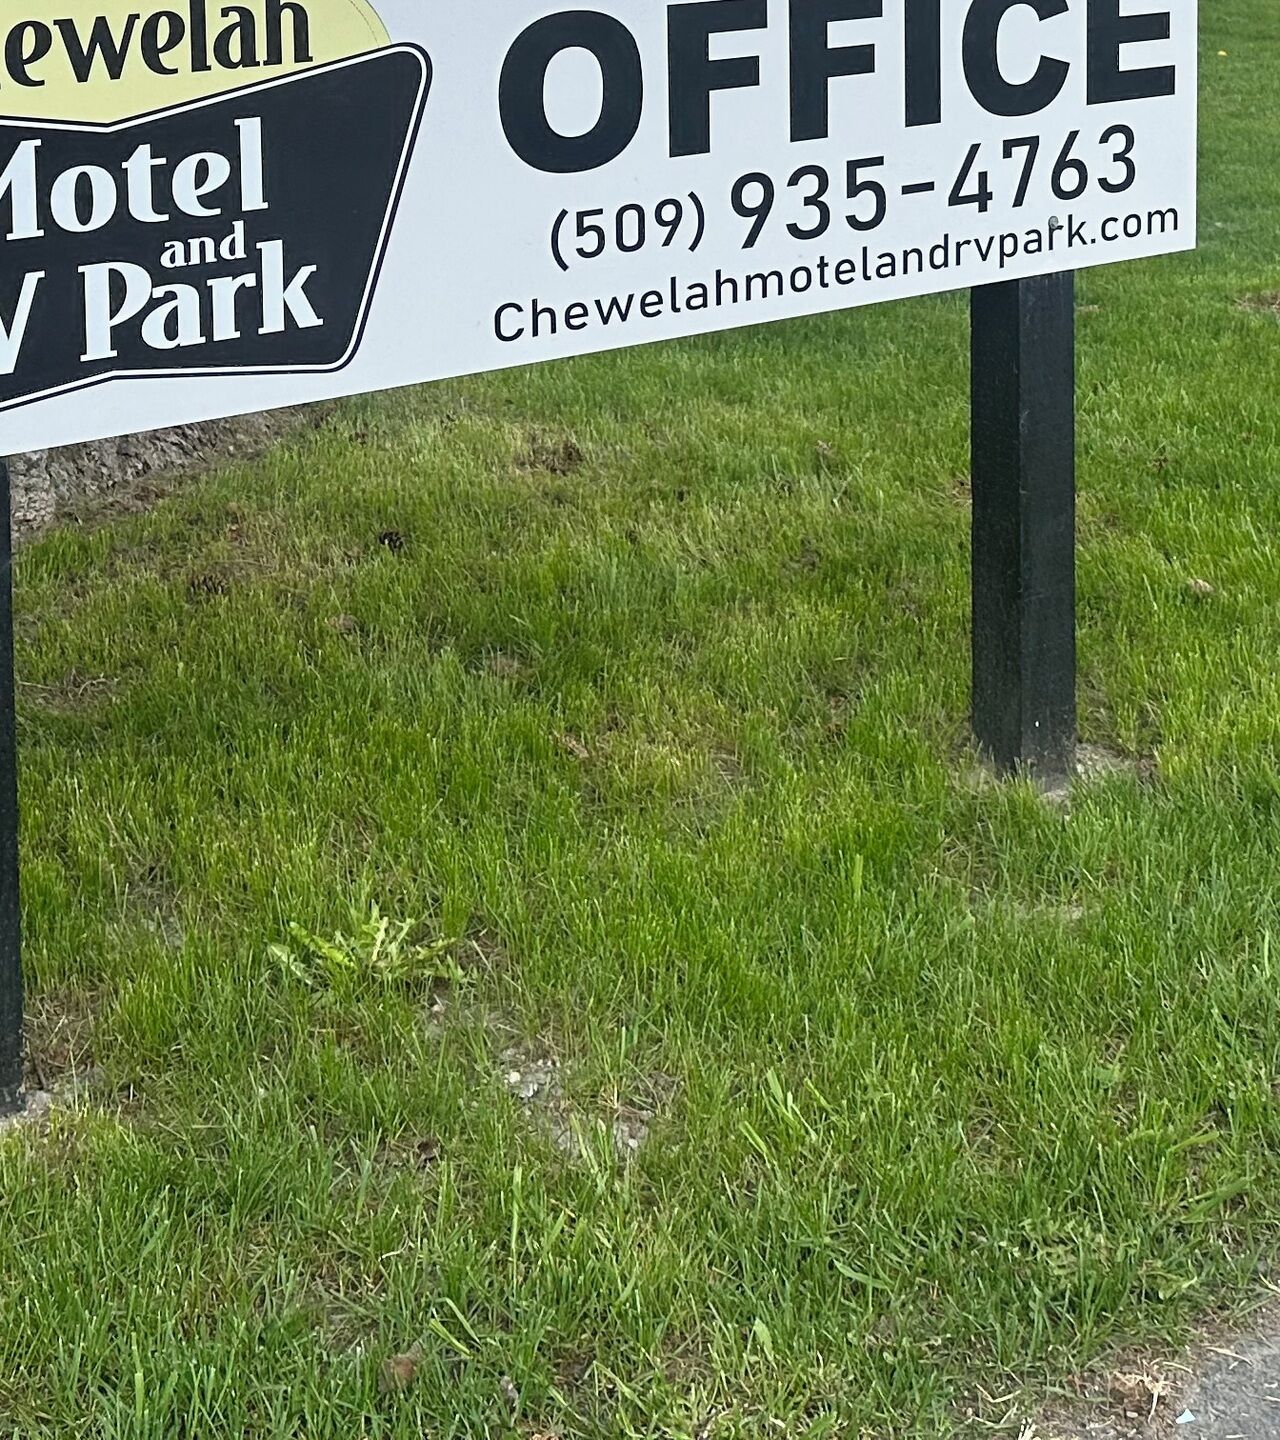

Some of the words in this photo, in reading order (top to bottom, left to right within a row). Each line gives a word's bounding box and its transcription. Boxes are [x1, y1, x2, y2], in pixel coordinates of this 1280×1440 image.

[159, 219, 248, 270] and
[550, 191, 706, 273] (509)
[730, 124, 1137, 251] 935-4763
[78, 239, 324, 363] Park
[493, 207, 1180, 343] Chewelahmotelandrvpark.com
